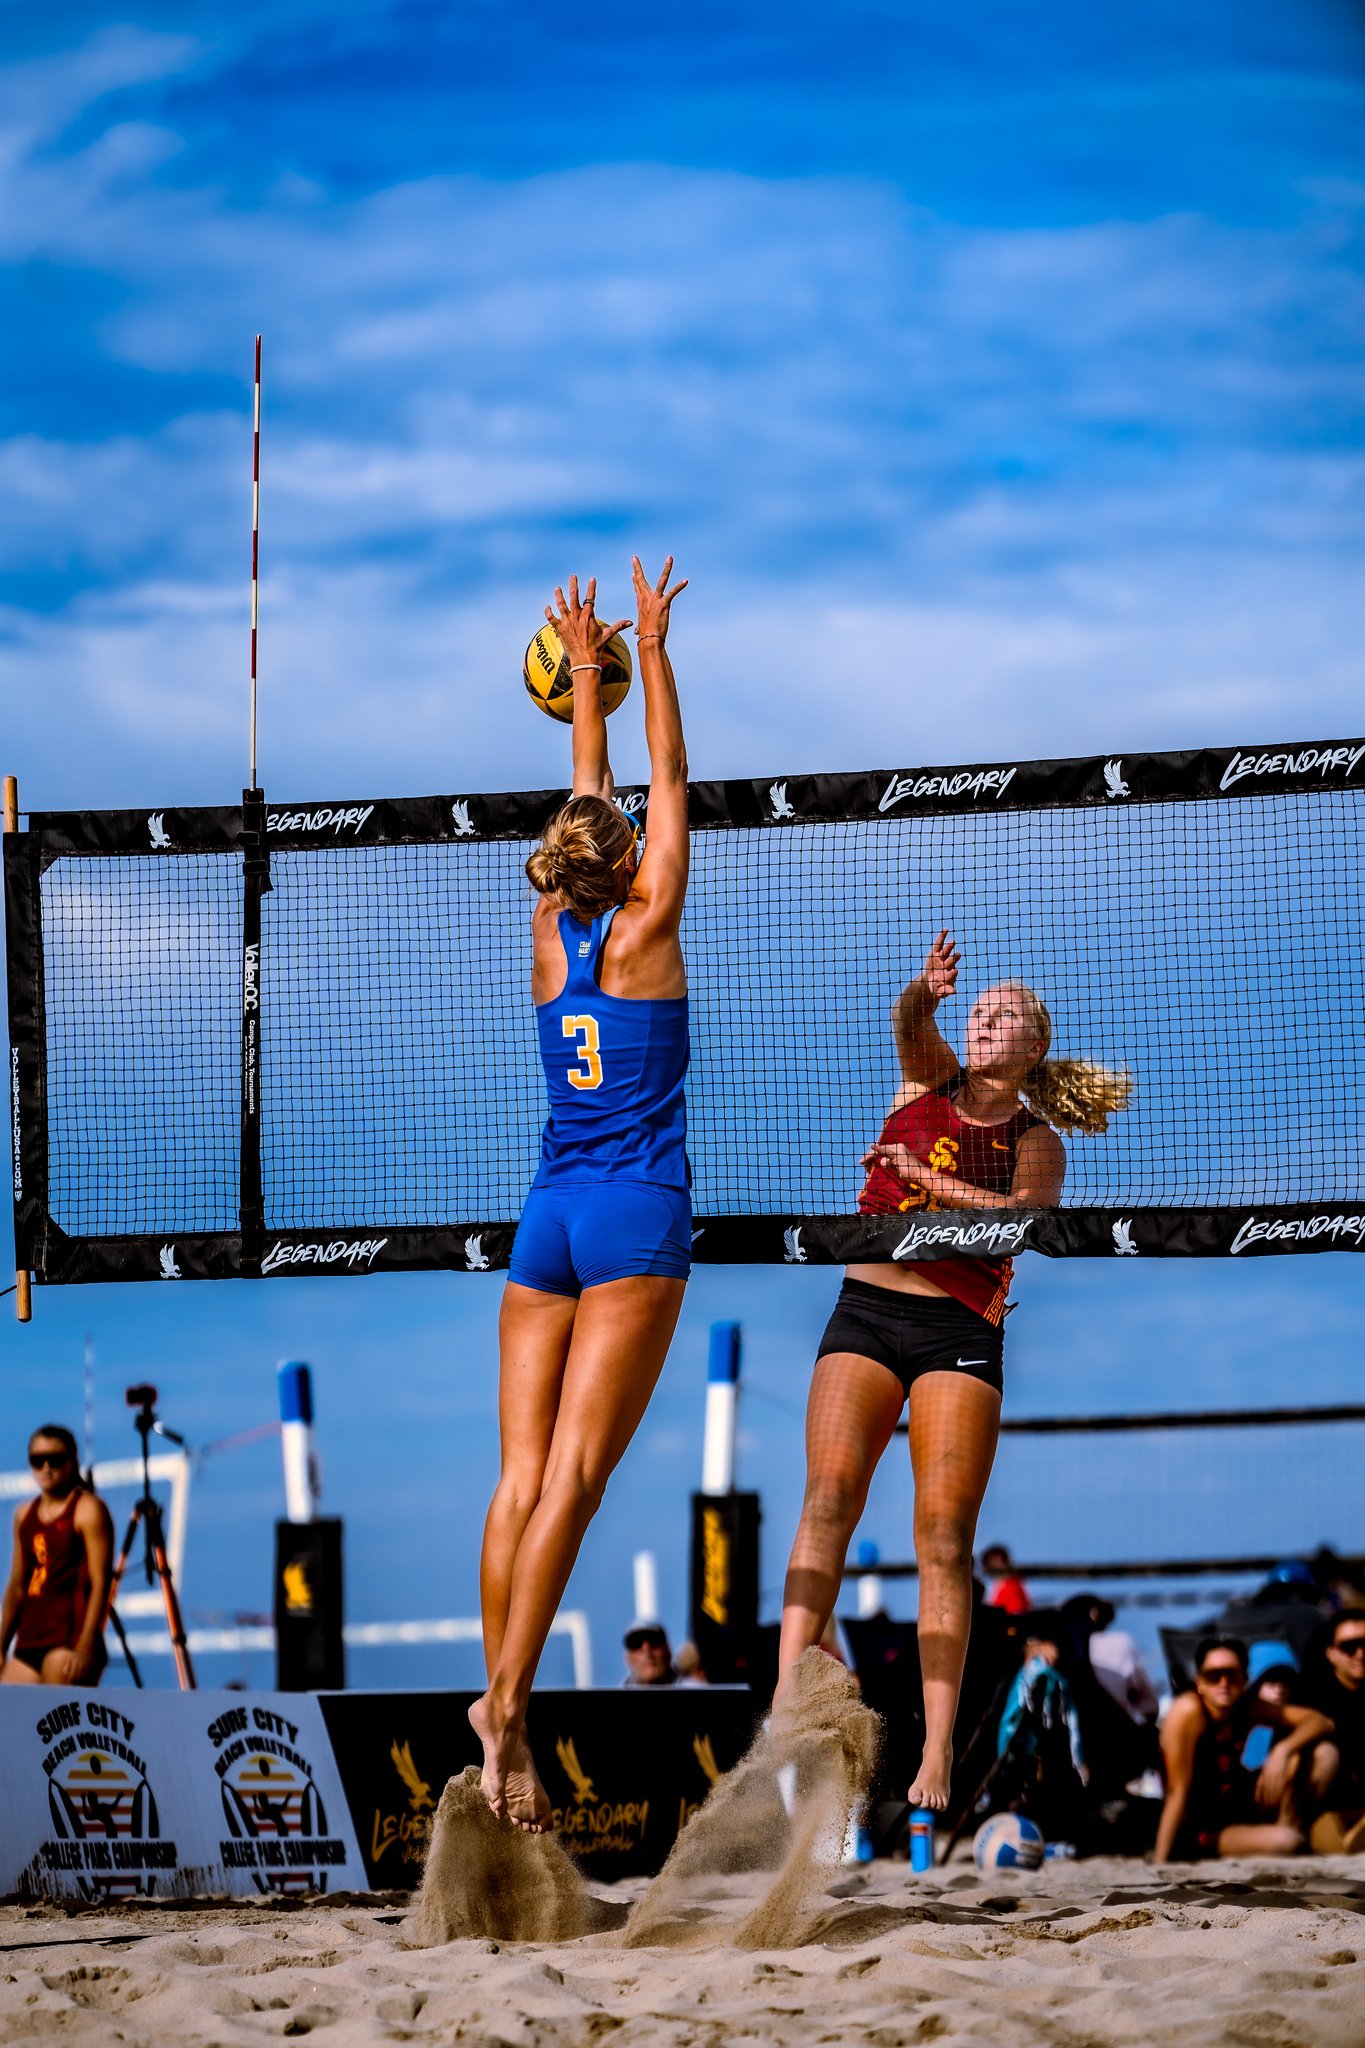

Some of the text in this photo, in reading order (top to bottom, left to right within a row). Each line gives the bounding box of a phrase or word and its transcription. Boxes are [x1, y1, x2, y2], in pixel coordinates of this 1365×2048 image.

[535, 633, 556, 676] Wilson
[878, 767, 1017, 812] LEGENDARY
[1219, 745, 1365, 791] LEGENDARY
[265, 804, 375, 836] EGENDARY
[248, 1047, 256, 1066] Club,
[562, 1014, 603, 1091] 3
[248, 1067, 256, 1114] Tournaments
[261, 1237, 389, 1275] LEGENDARY
[892, 1219, 1034, 1261] LEGENDARY
[36, 1702, 135, 1745] SURF CITY
[207, 1707, 299, 1748] SURF CITY
[42, 1732, 147, 1778] BEACH VOLLEYBALL
[214, 1735, 312, 1778] BEACH VOLLEYBALL
[44, 1842, 84, 1870] COLLEGE
[219, 1841, 258, 1868] COLLEGE
